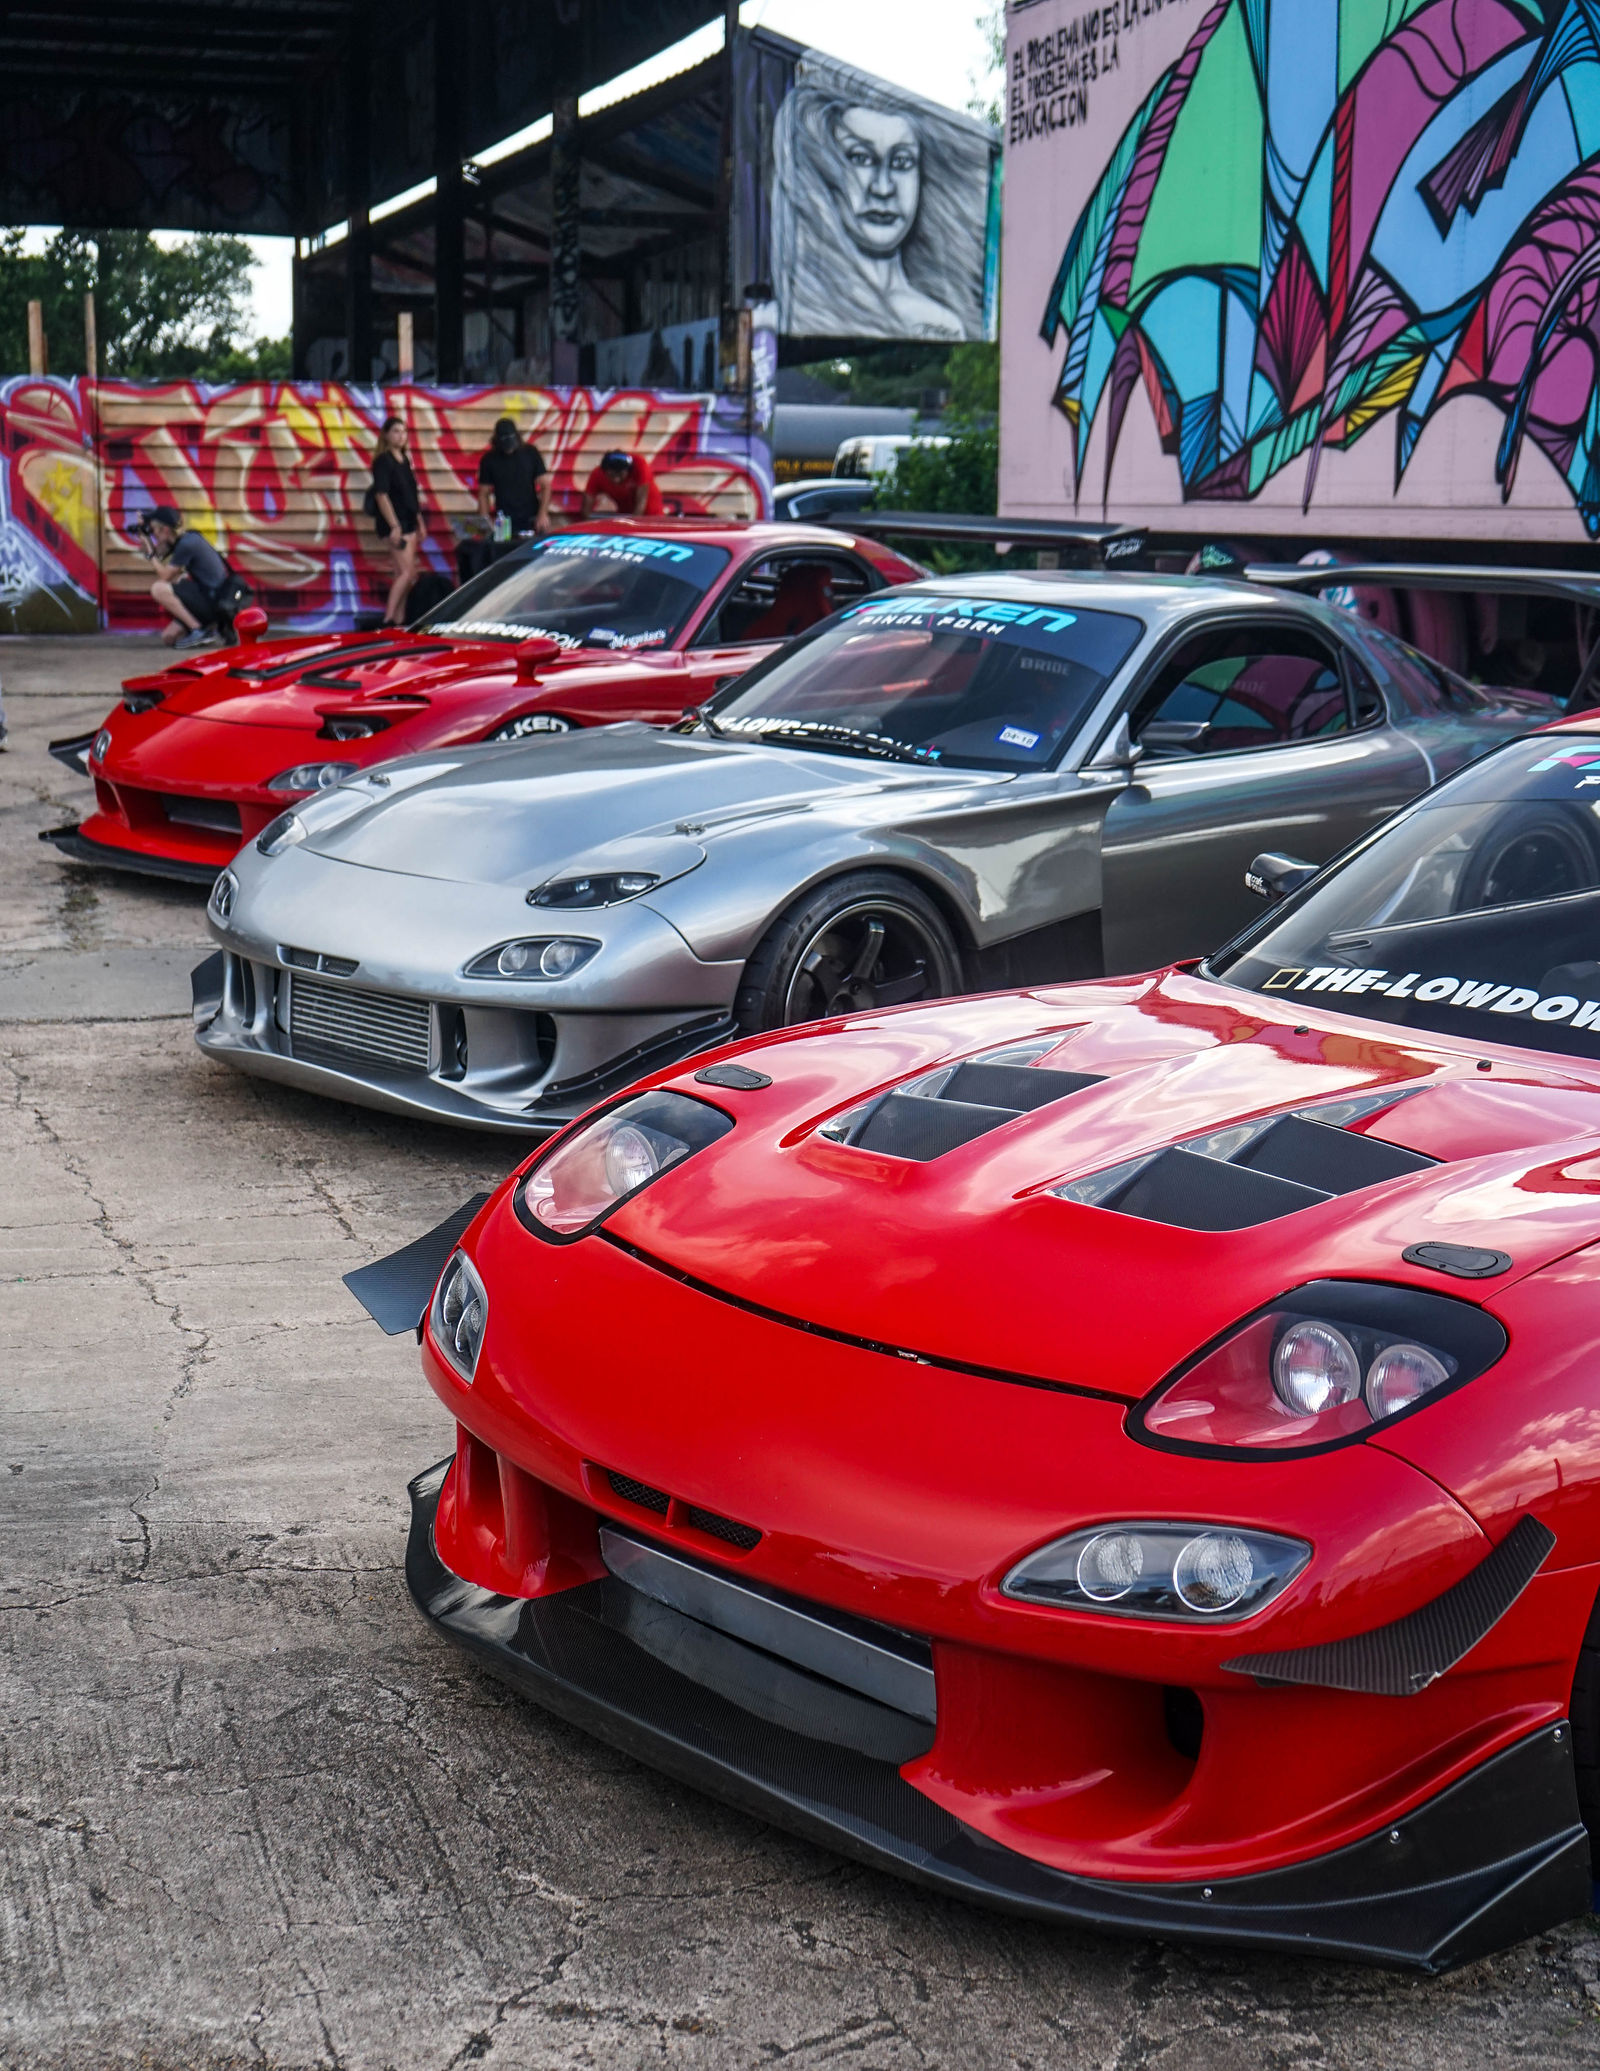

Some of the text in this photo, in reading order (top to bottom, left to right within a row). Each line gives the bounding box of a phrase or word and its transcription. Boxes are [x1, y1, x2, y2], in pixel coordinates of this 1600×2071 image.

[1012, 46, 1025, 81] EL
[1027, 18, 1080, 70] PROBLEMA
[1082, 10, 1100, 47] NO
[1103, 1, 1119, 39] ES
[1011, 39, 1120, 112] EL PROBLEMA ES LA
[1010, 86, 1088, 144] EDUCACION
[532, 534, 694, 563] FALKEN
[840, 596, 1078, 633] FALKEN
[857, 614, 1007, 635] FINAL FORM
[1020, 656, 1072, 677] BRIDE
